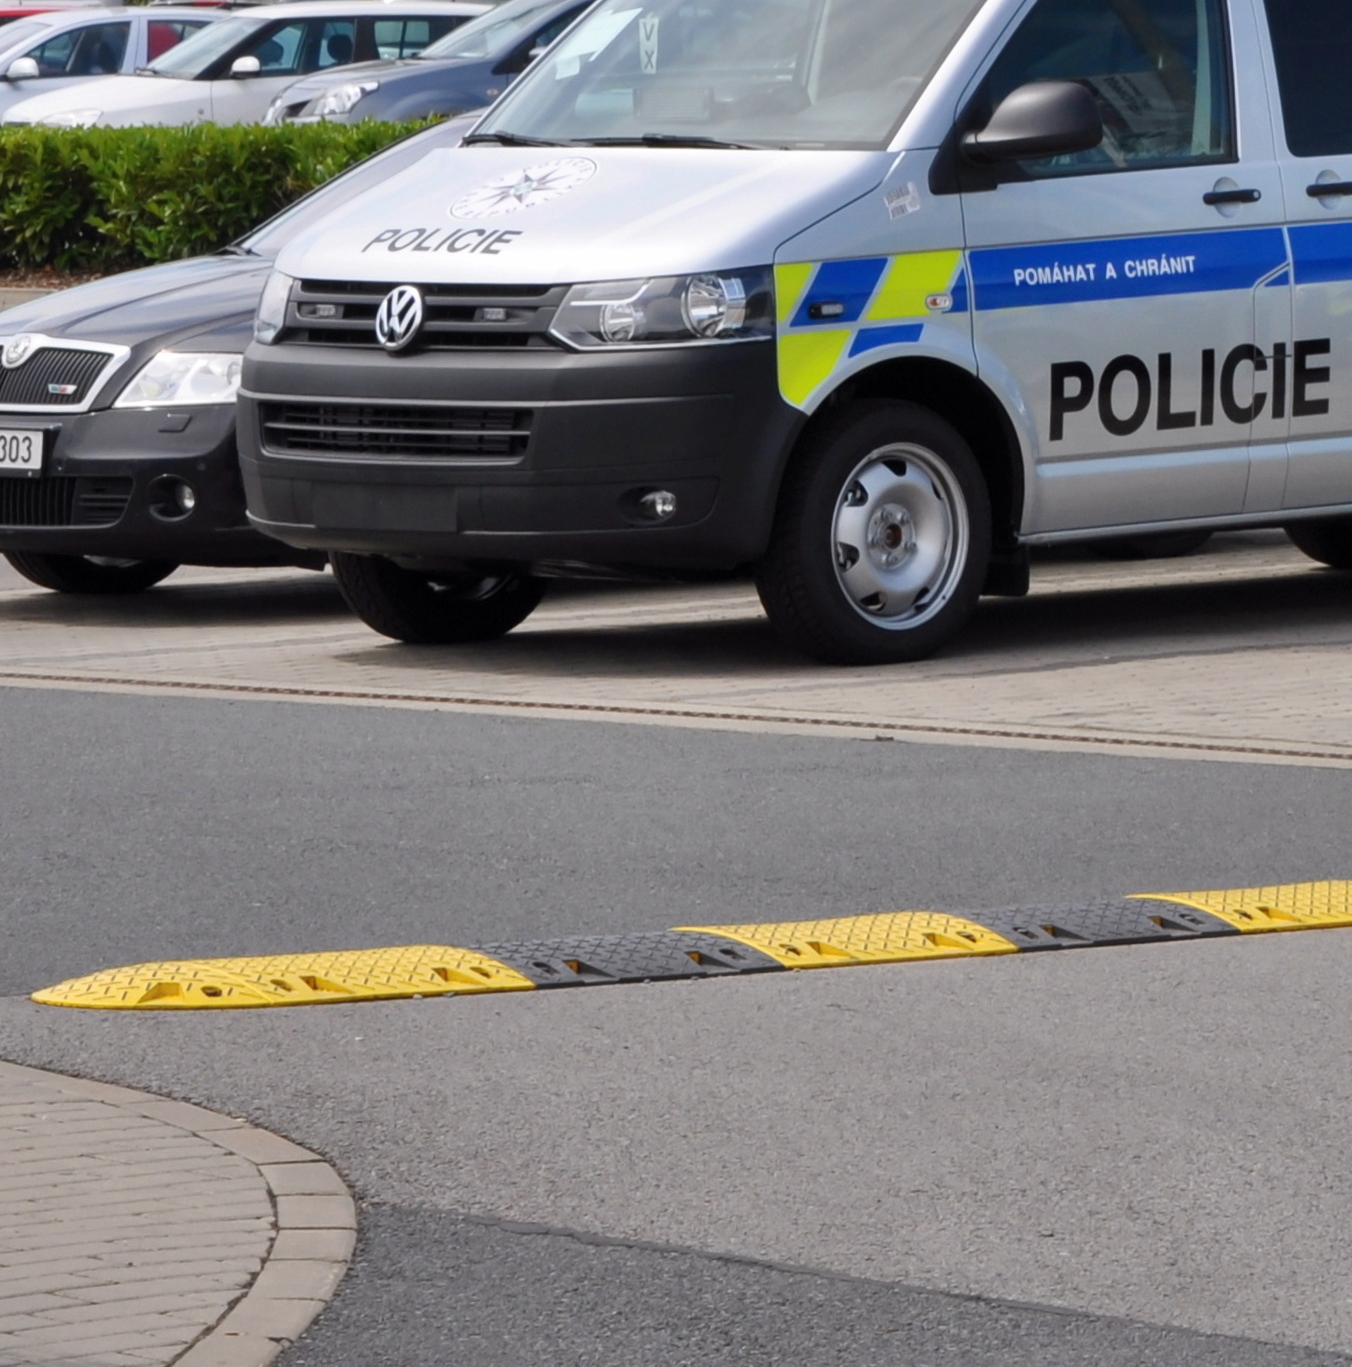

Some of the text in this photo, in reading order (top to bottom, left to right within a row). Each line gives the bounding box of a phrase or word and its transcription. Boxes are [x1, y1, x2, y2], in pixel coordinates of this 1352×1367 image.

[361, 228, 524, 255] POLICIE
[1013, 254, 1196, 286] POMÁHAT A CHRÁNIT
[1049, 338, 1331, 442] POLICIE
